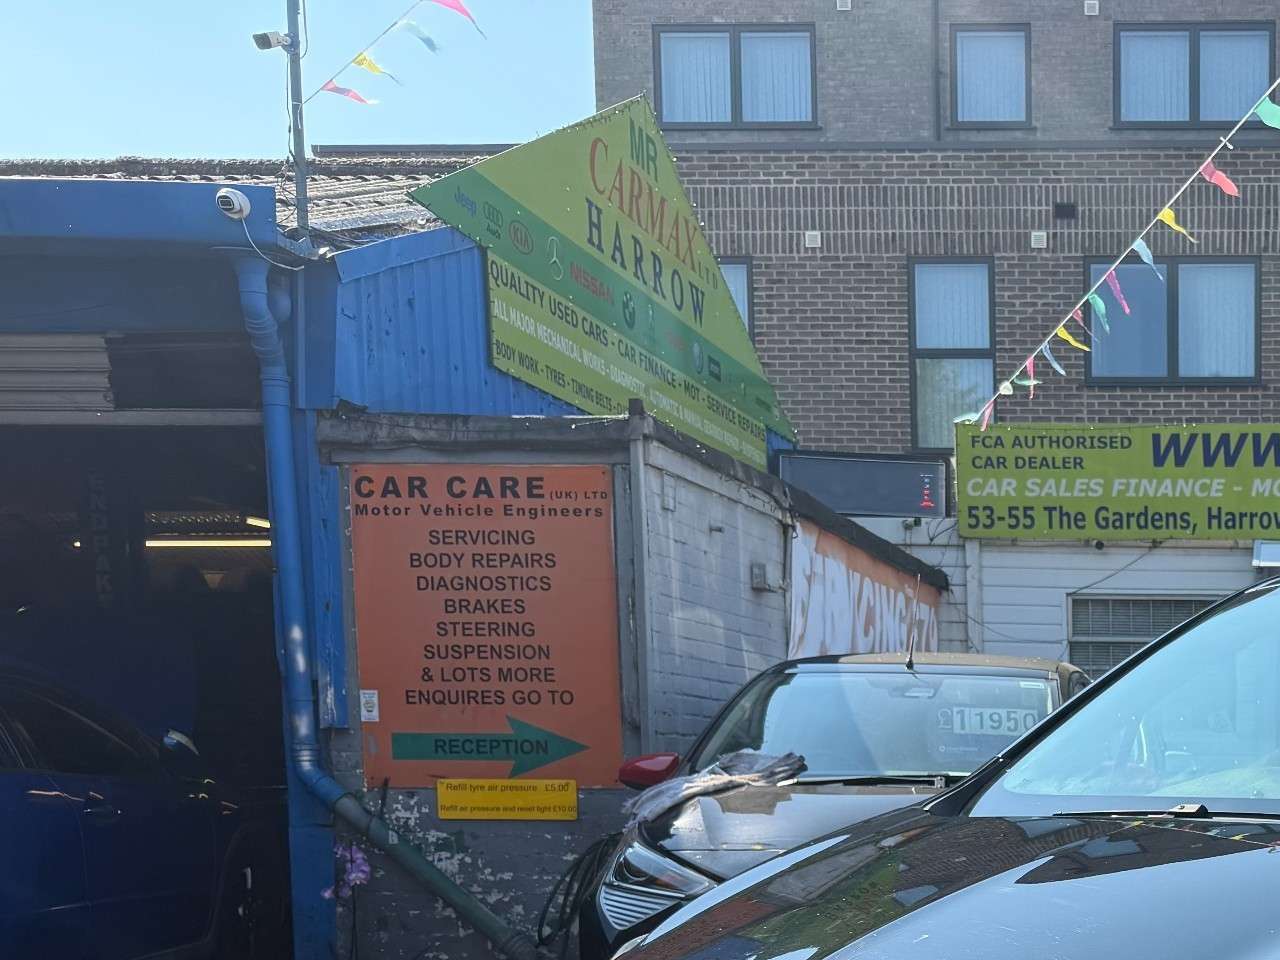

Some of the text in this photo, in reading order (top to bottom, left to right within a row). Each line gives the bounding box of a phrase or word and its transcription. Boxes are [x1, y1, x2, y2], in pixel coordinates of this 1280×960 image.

[629, 117, 658, 182] MR
[590, 137, 719, 290] CARMAX LTD
[585, 197, 706, 328] HARROW
[493, 298, 510, 323] ALL
[511, 305, 536, 338] MAJOR
[537, 322, 582, 364] MECHANICAL
[490, 259, 545, 308] QUALITY
[549, 295, 579, 328] USED
[582, 315, 609, 346] CARS
[618, 339, 637, 364] CAR
[639, 354, 677, 389] FINANCE
[683, 379, 701, 401] MOT
[707, 394, 737, 426] SERVICE
[495, 338, 516, 362] BODY
[518, 350, 540, 375] WORK
[545, 364, 566, 388] TYRES
[971, 435, 1132, 449] FCA AUTHORISED
[972, 456, 1084, 470] CAR DEALER
[354, 475, 608, 501] CAR CARE (UK) LTD
[967, 477, 1017, 497] CAR
[1025, 477, 1104, 497] SALES
[1112, 477, 1225, 497] FINANCE
[354, 504, 604, 520] Motor Vehicle Engineers
[967, 505, 1035, 530] 53-55
[1044, 505, 1087, 530] The
[1094, 505, 1197, 535] Gardens,
[428, 529, 536, 546] SERVICING
[409, 552, 557, 569] BODY REPAIRS
[416, 575, 552, 592] DIAGNOSTICS
[444, 598, 526, 615] BRAKES
[436, 621, 536, 637] STEERING
[423, 644, 551, 660] SUSPENSION
[421, 667, 556, 682] & LOTS MORE
[405, 689, 575, 706] ENQUIRES GO TO
[434, 738, 549, 755] RECEPTION
[446, 782, 468, 792] Refill
[468, 783, 486, 794] tyre
[487, 783, 499, 792] air
[500, 784, 538, 794] pressure
